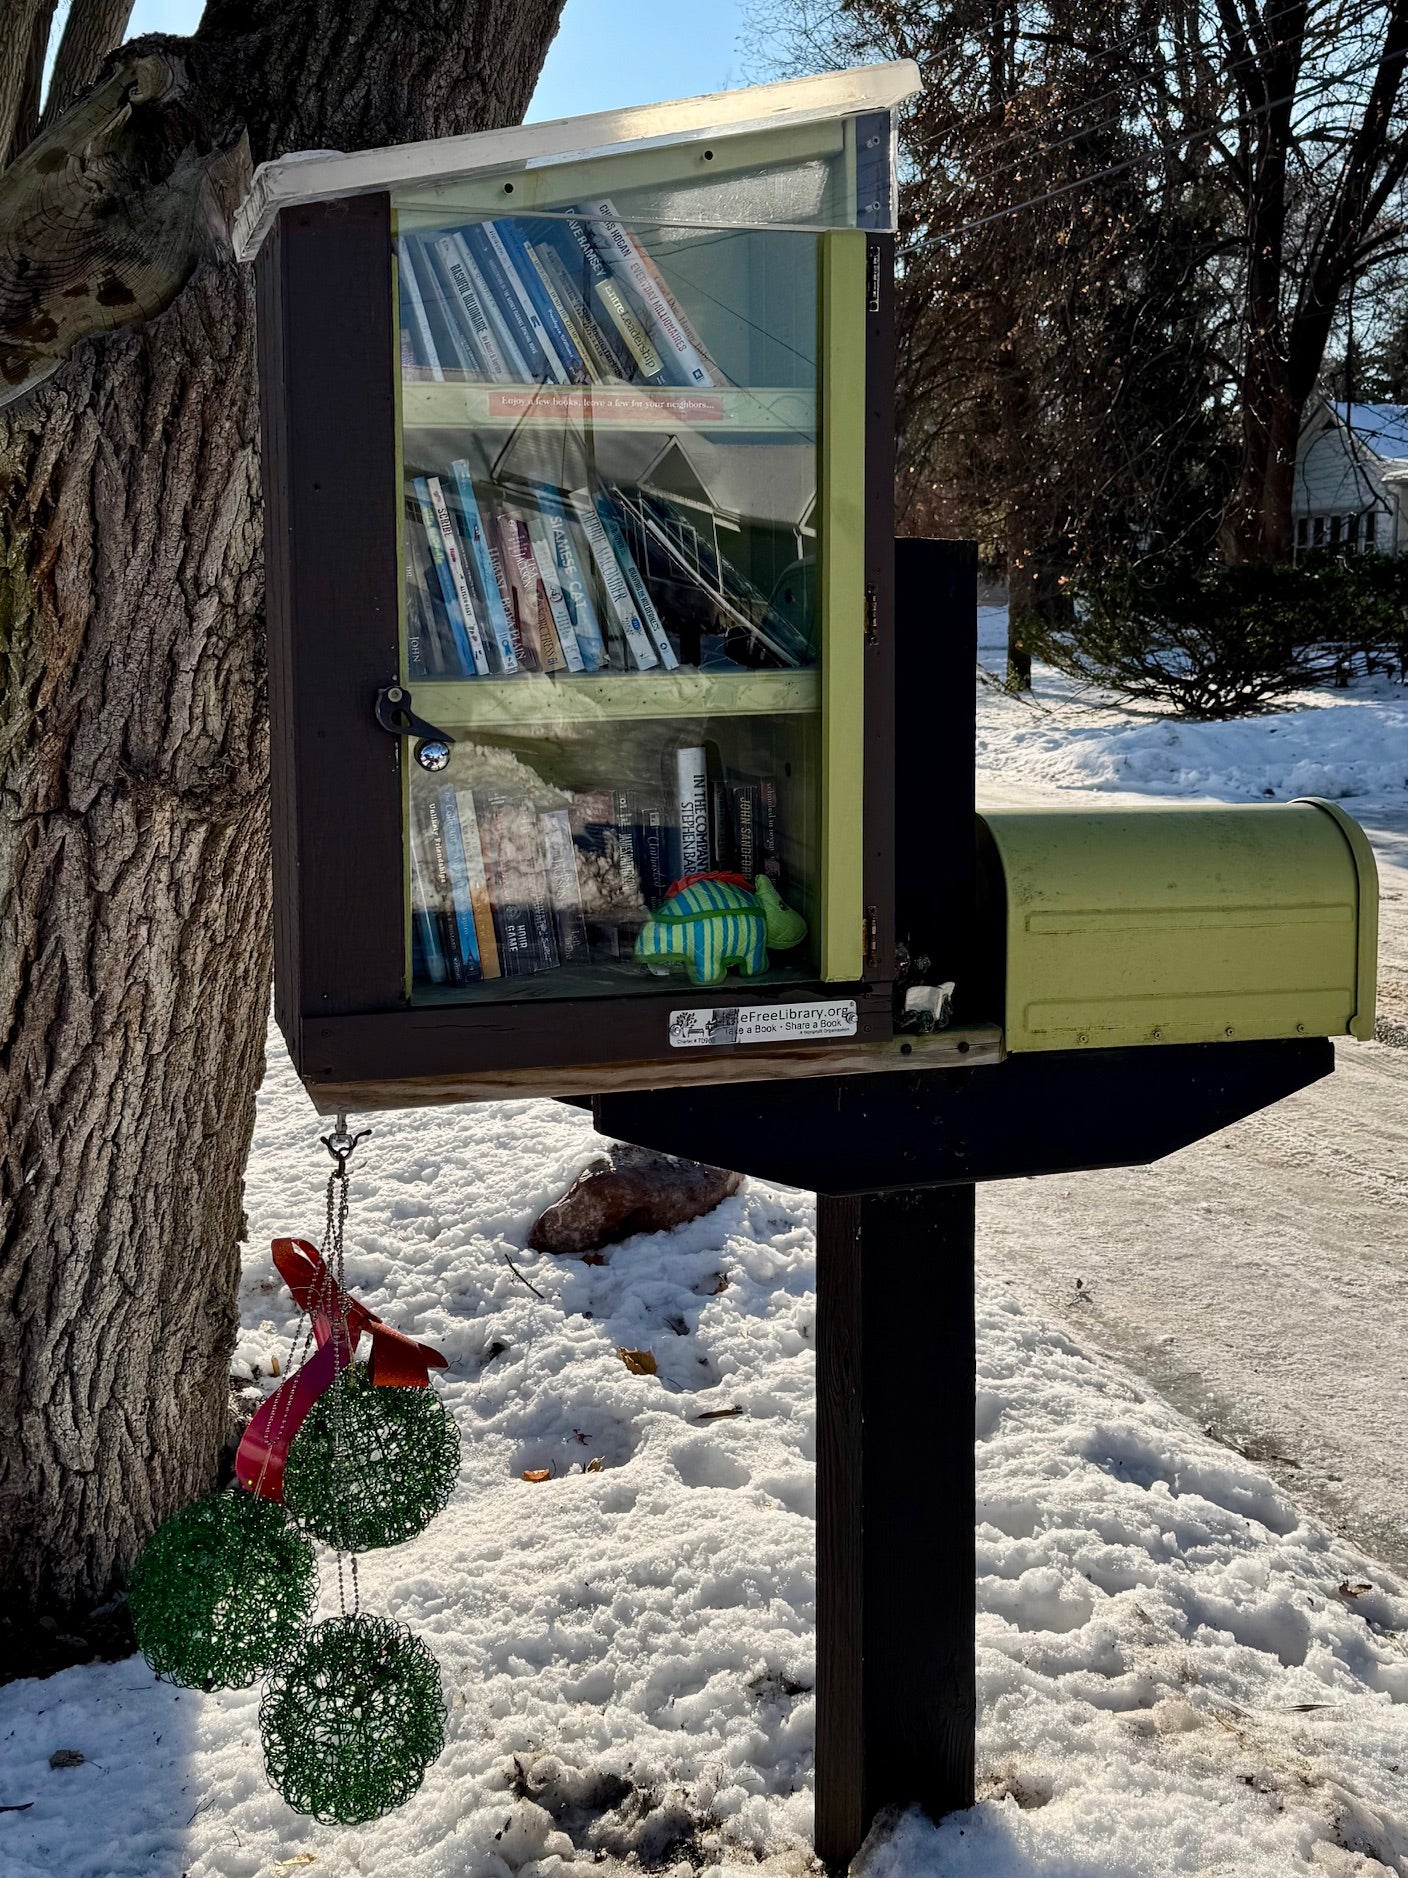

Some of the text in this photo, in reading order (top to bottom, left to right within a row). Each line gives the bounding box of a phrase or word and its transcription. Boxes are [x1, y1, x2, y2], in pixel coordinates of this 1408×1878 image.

[565, 208, 583, 238] DAVE
[577, 237, 606, 276] RAMSEY
[611, 229, 632, 257] HOGAN
[450, 263, 470, 295] BASHFUL
[463, 294, 488, 333] BILLIONAIRE
[631, 262, 687, 352] EVERYDAY MILLIONAIRES
[502, 396, 526, 406] Enjoy
[552, 398, 581, 407] books,
[584, 398, 605, 406] leave
[615, 399, 630, 407] few
[632, 399, 643, 407] for
[645, 401, 665, 410] your
[667, 399, 714, 411] neighbors...
[511, 553, 533, 588] JACKSON
[526, 557, 538, 581] LISA
[551, 516, 588, 609] SIAMESE CAT
[582, 510, 628, 603] DEBBIE MACOMBER
[408, 636, 420, 662] JOHN
[511, 631, 526, 661] PLAIN
[693, 774, 709, 873] IN THE COMPANY
[739, 797, 750, 824] JOHN
[428, 803, 447, 883] Unlikely Friendships
[681, 802, 695, 876] STEPHEN BAR
[504, 925, 518, 952] GAME
[516, 924, 529, 949] HOUR
[722, 1007, 849, 1022] eFreeLibrary.org
[755, 1024, 776, 1034] Book
[785, 1021, 810, 1031] Share
[821, 1019, 842, 1028] Book
